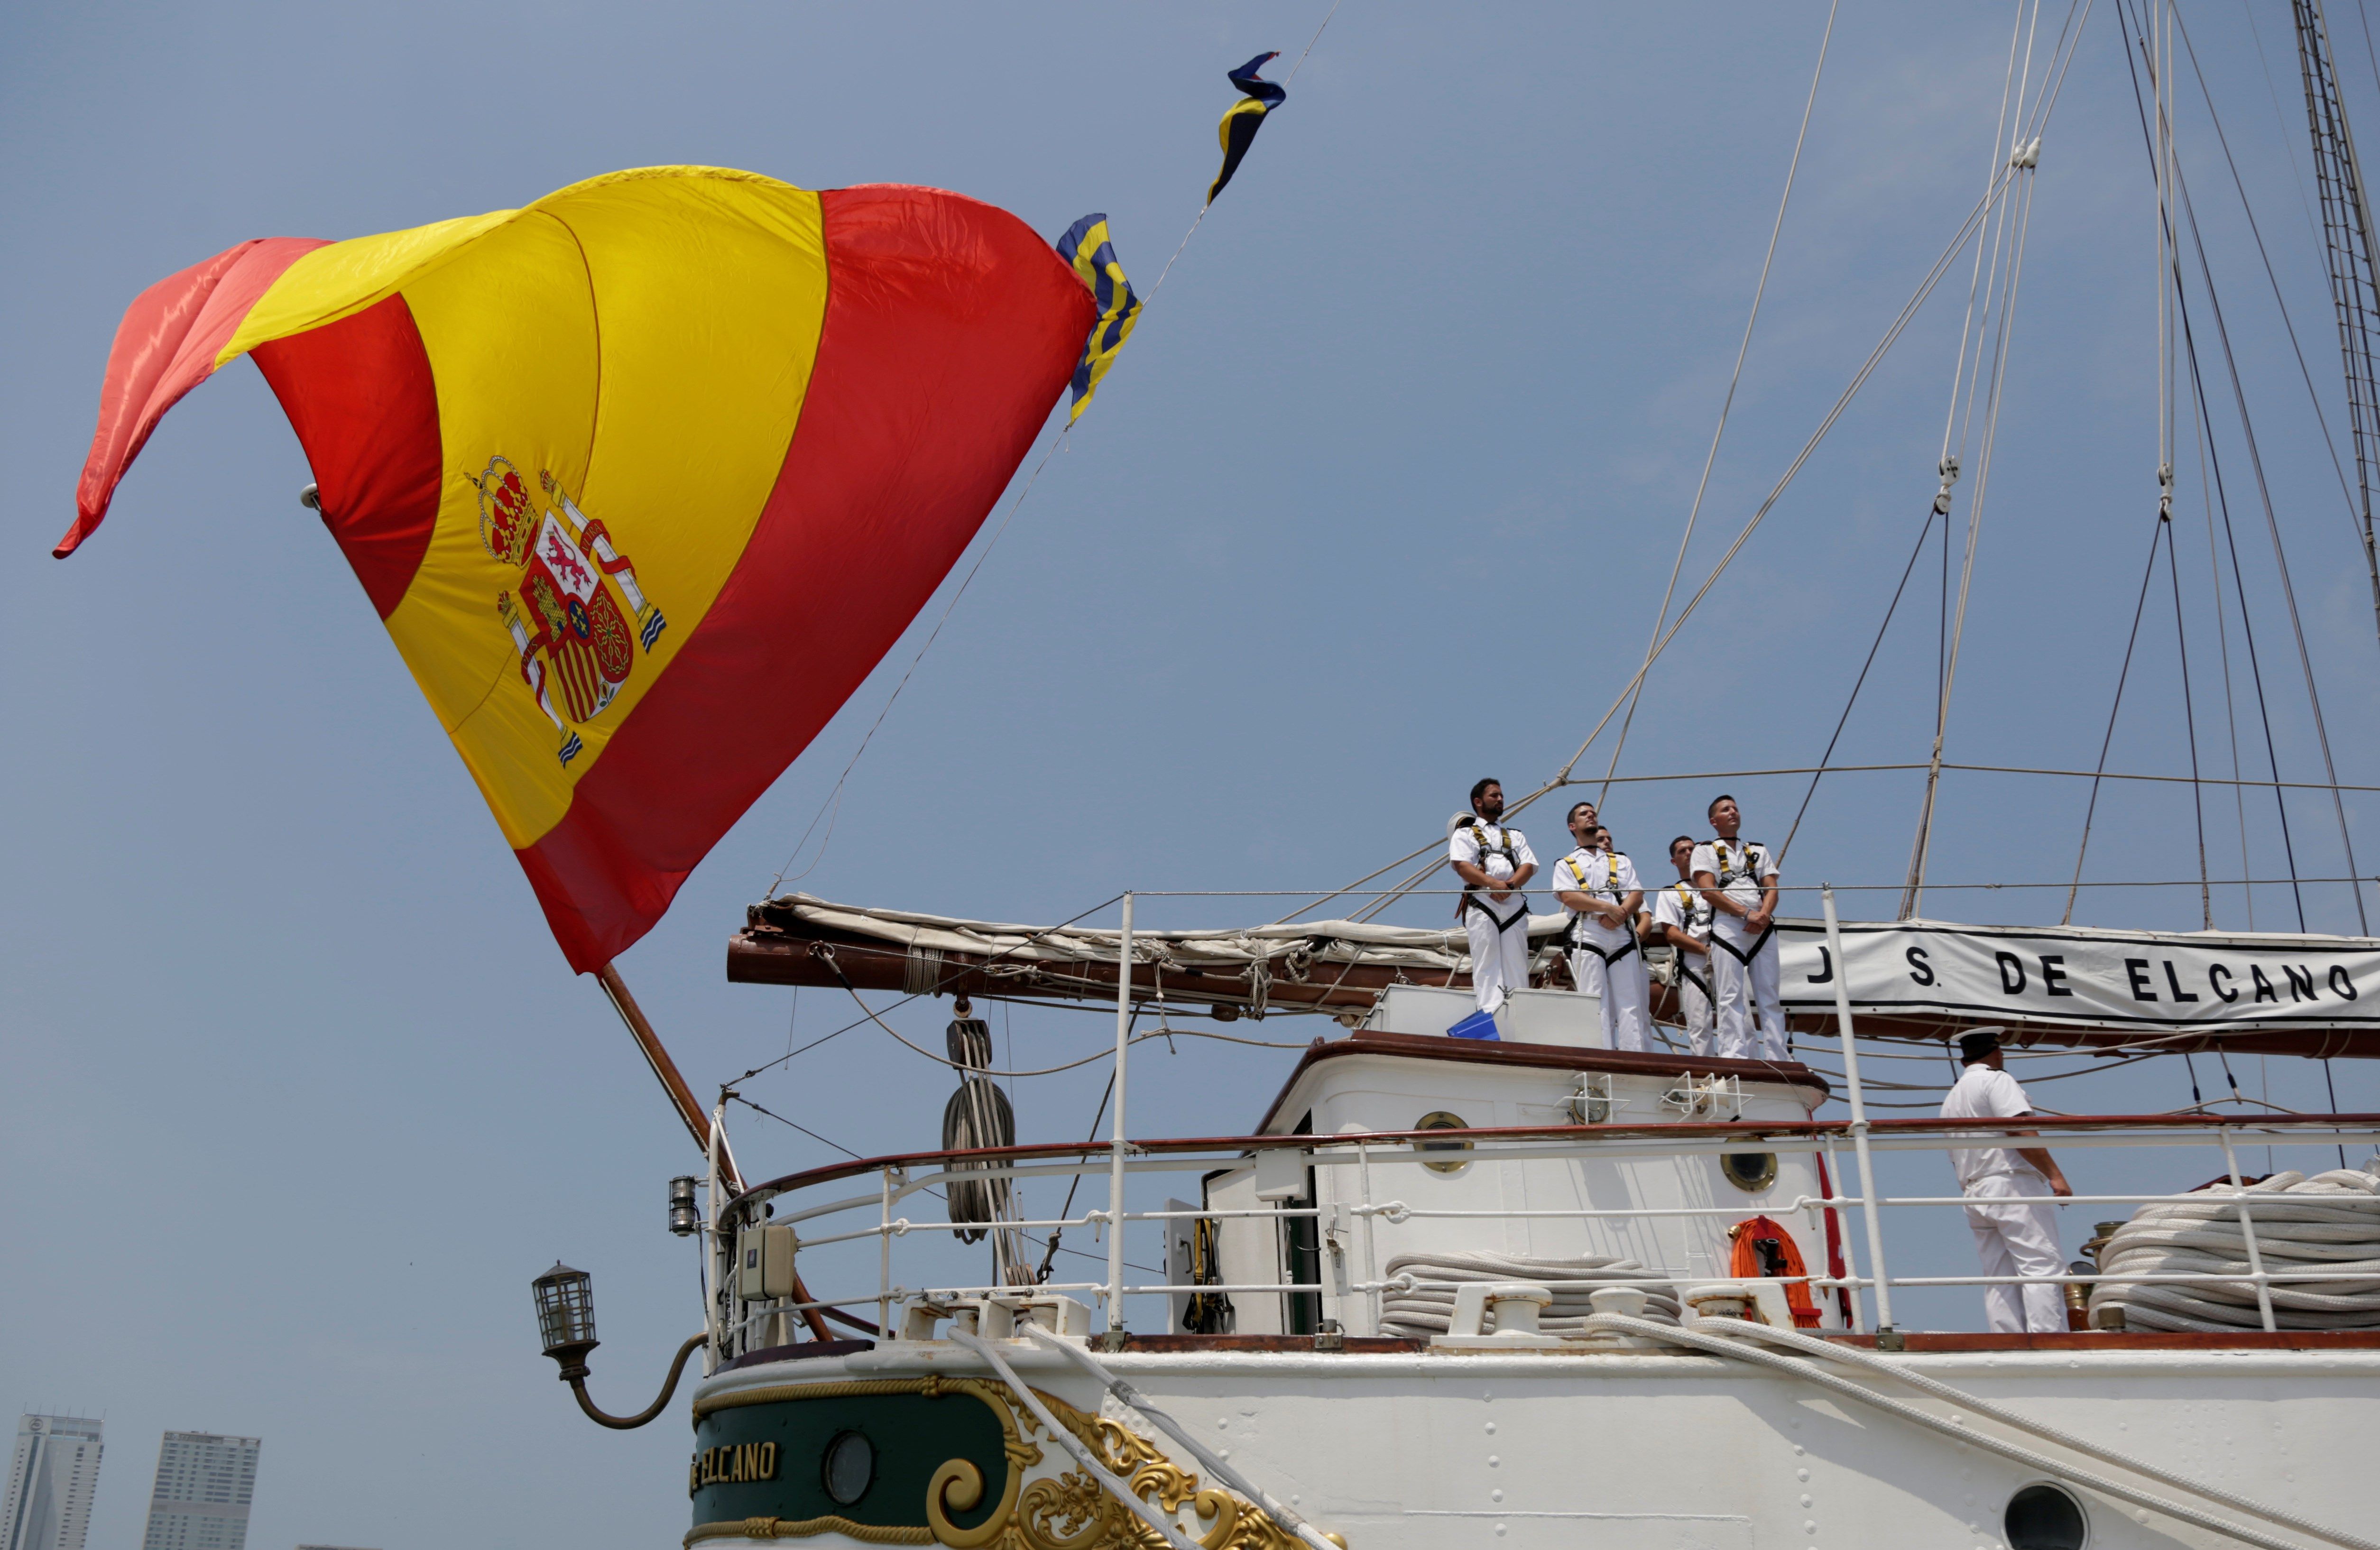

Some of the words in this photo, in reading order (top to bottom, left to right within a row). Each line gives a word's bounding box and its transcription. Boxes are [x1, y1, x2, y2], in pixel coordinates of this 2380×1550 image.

[1995, 951, 2074, 996] DE
[2124, 958, 2358, 1003] ELCANO
[701, 1441, 776, 1485] ELCANO
